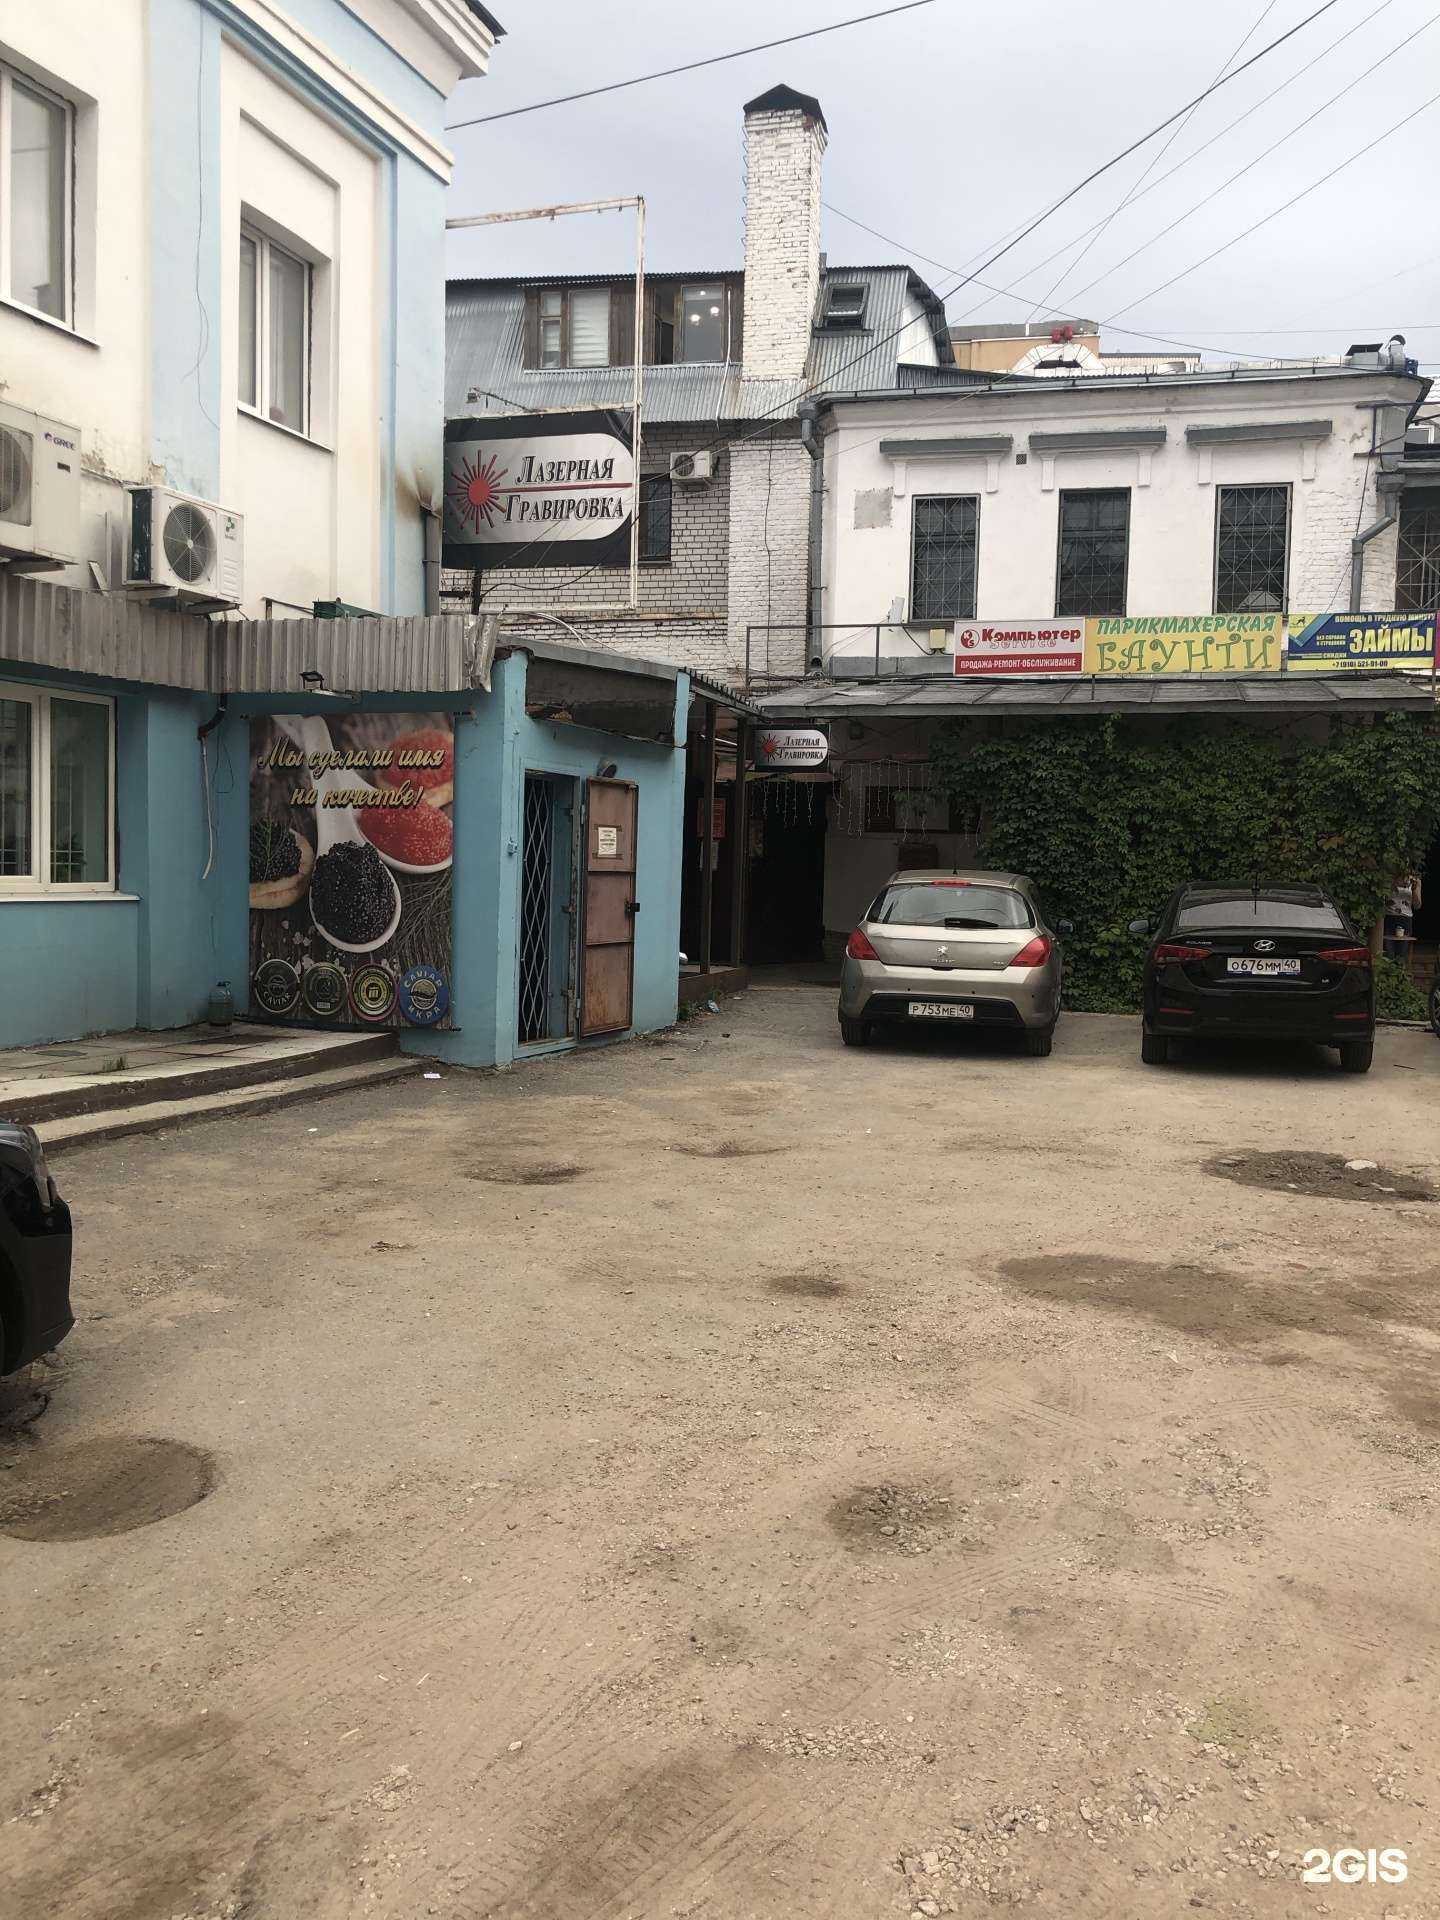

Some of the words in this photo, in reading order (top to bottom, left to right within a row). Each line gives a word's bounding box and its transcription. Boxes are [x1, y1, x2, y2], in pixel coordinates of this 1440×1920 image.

[516, 455, 615, 484] ЛАЗЕРНАЯ
[504, 494, 624, 523] ГРАВИРОВКА
[982, 628, 1081, 642] Компьютер
[1097, 615, 1276, 635] ПАРИКМАХЕРСКАЯ
[1349, 624, 1434, 653] ЗАЙМЫ
[1097, 633, 1275, 673] БАУНТИ
[783, 735, 820, 746] ЛАЗЕРНАЯ
[257, 736, 304, 769] Мы
[307, 749, 393, 780] сделали
[397, 749, 447, 769] имя
[779, 748, 824, 759] ГРАВИРОВКА
[289, 787, 319, 807] на
[320, 778, 424, 809] качестве!
[1284, 960, 1297, 969] 40
[960, 1005, 971, 1014] 40
